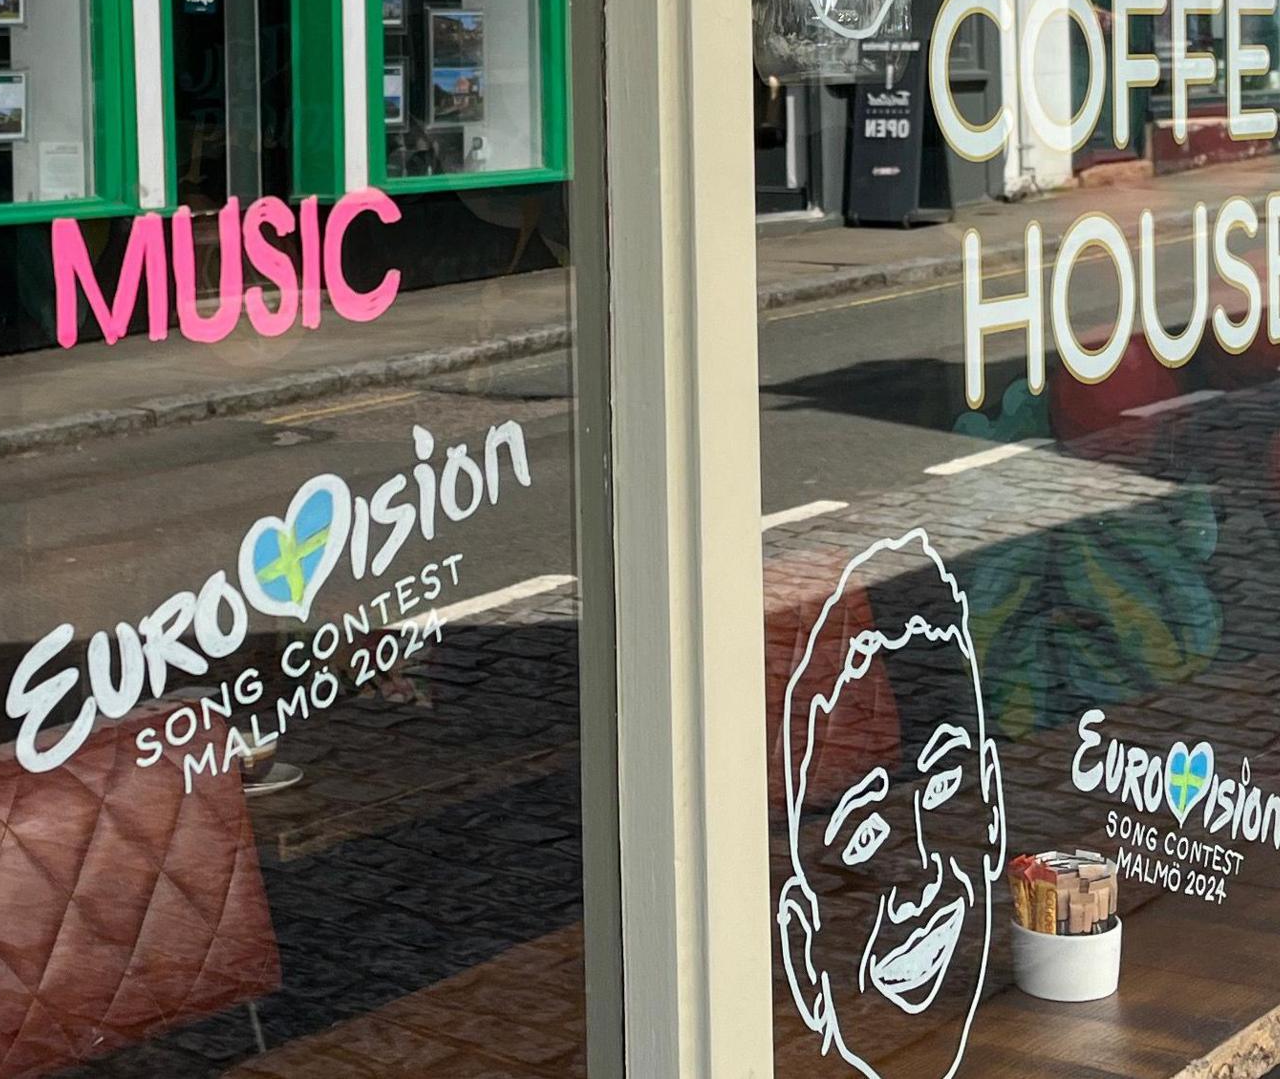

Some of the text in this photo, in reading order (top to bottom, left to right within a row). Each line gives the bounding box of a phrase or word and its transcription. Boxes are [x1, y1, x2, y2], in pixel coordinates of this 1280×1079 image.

[51, 187, 402, 349] MUSIC
[134, 553, 465, 768] SONG CONTEST
[183, 609, 448, 794] MALMÖ 2024
[1105, 810, 1244, 876] SONG CONTEST
[1116, 846, 1227, 905] MALMÖ 2024
